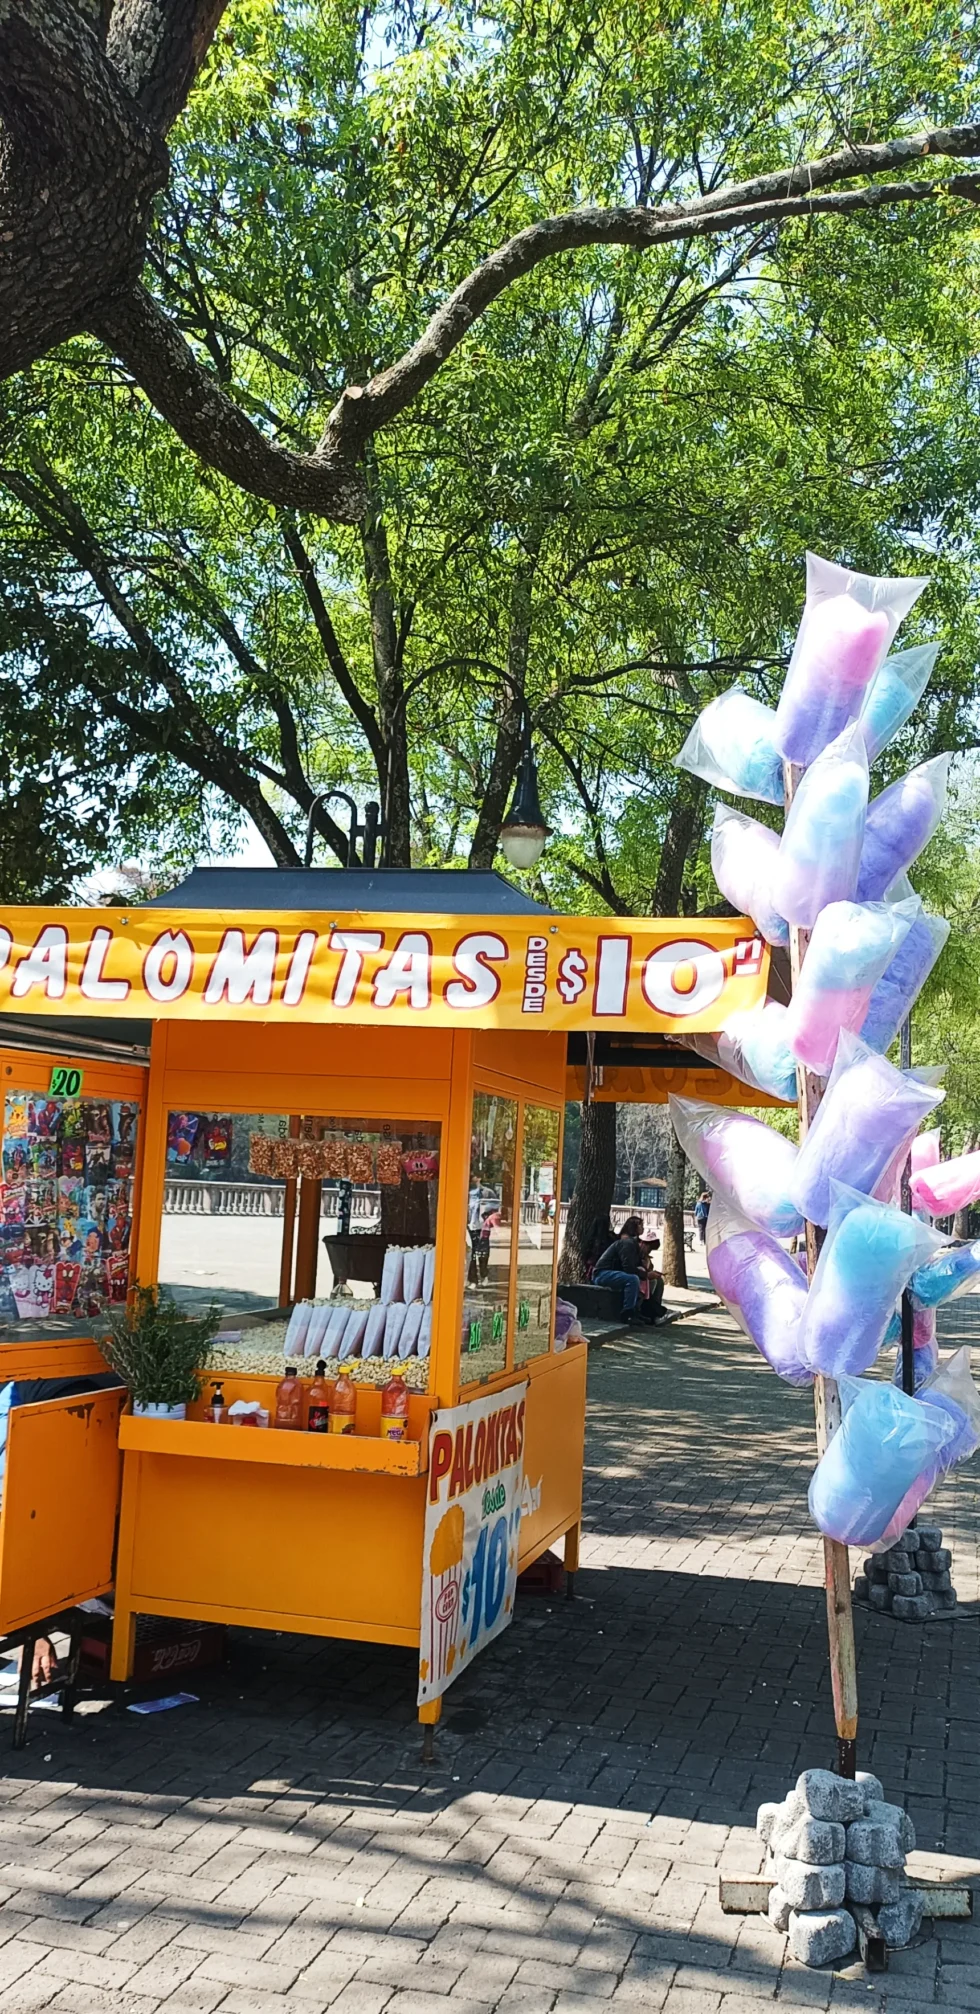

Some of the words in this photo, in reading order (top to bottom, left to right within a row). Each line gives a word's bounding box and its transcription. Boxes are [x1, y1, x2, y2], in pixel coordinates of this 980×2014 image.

[521, 936, 549, 1013] DESDE
[52, 1069, 81, 1097] $20
[428, 1400, 525, 1506] PALOMITAS
